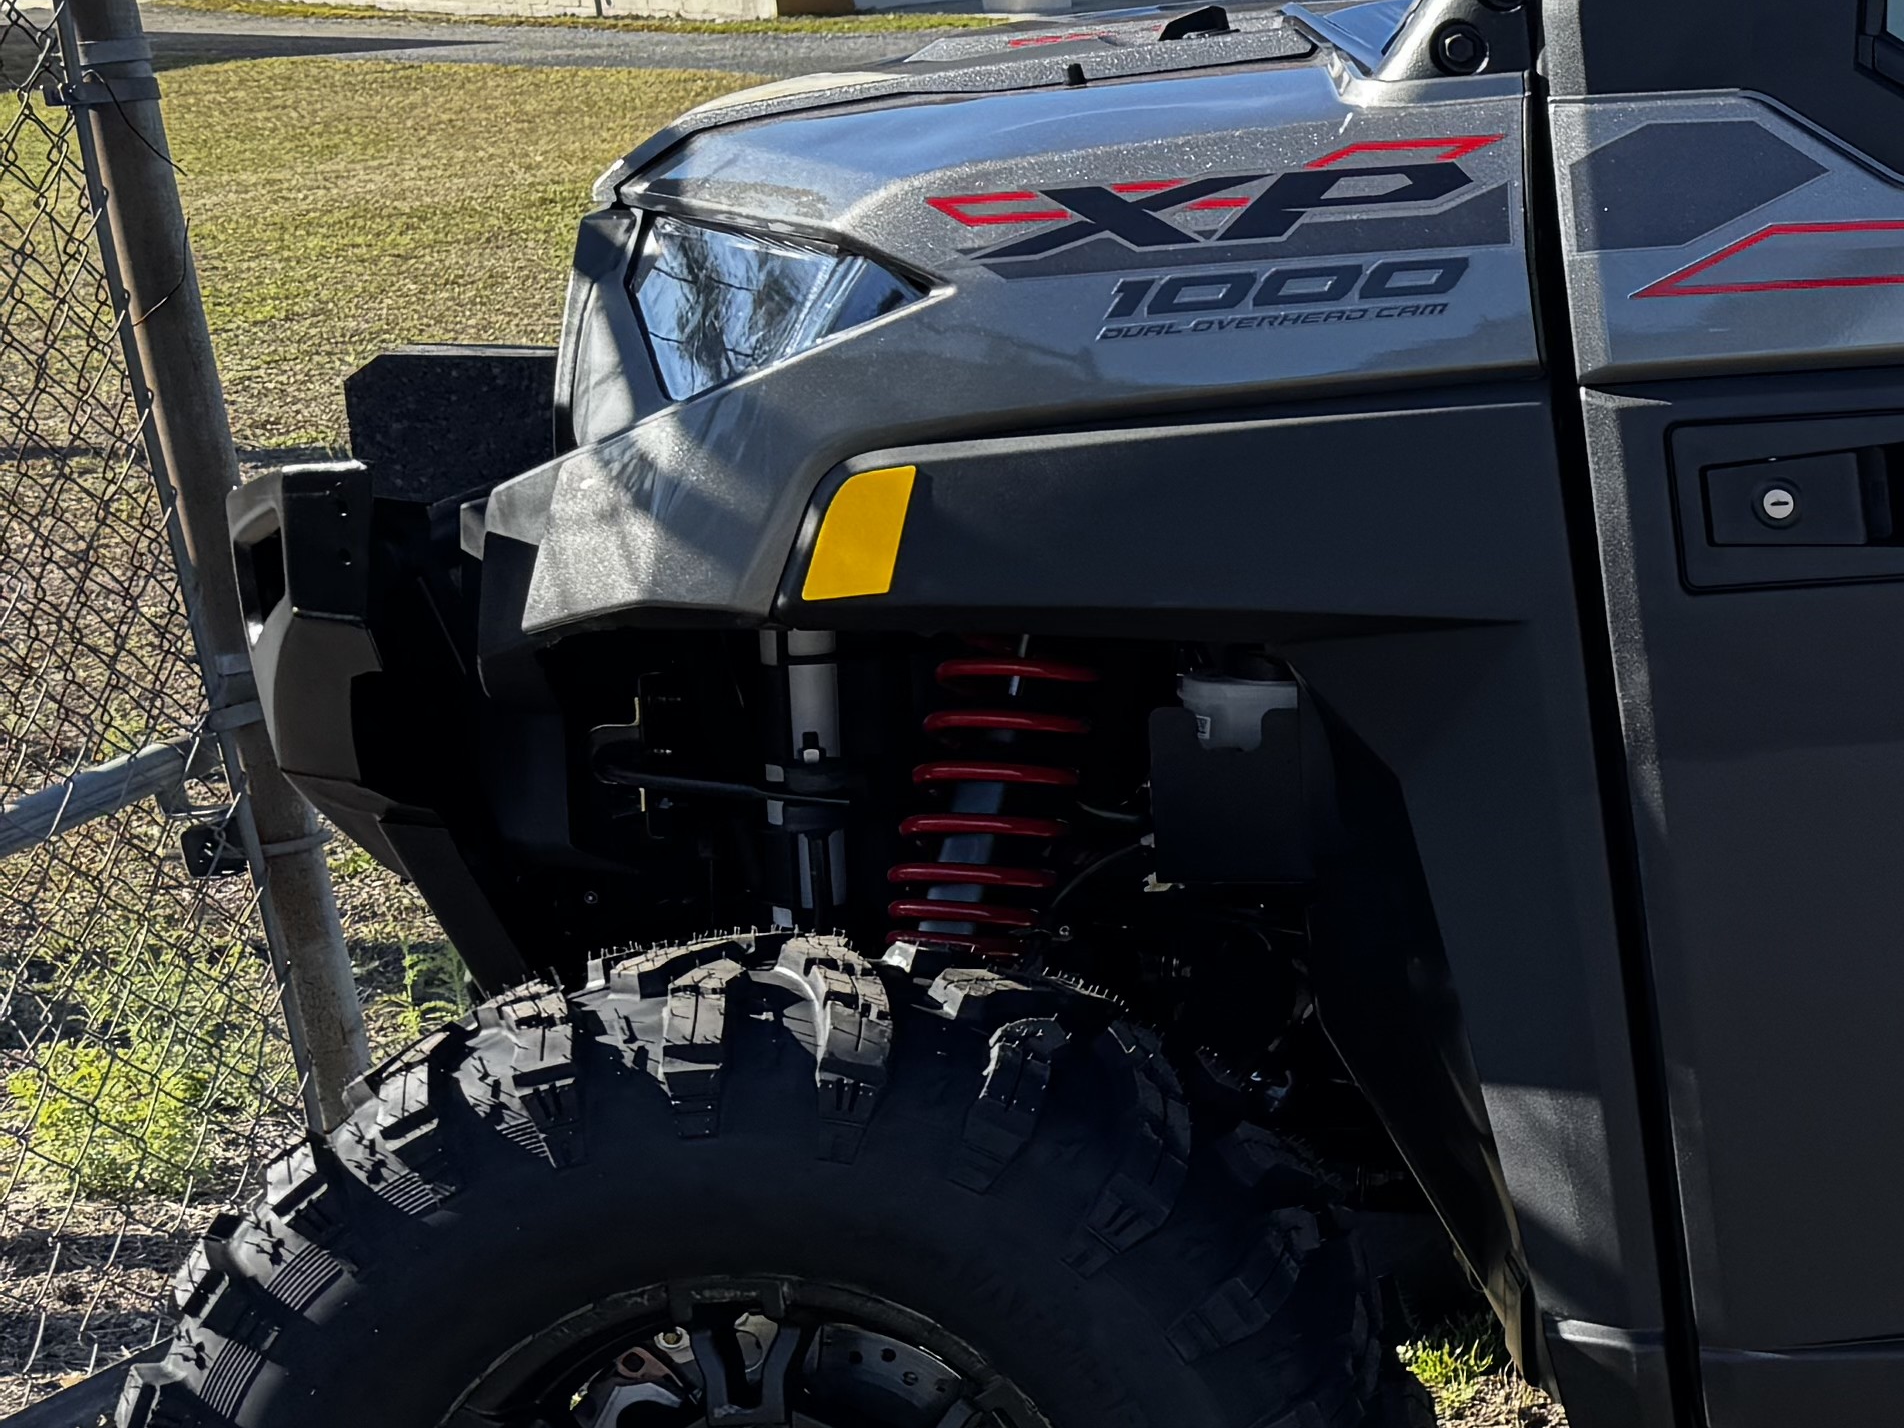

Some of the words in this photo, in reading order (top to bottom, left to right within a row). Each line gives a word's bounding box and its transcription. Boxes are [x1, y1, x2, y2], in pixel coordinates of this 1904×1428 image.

[969, 161, 1474, 260] XP
[1103, 256, 1470, 320] 1000
[1097, 322, 1184, 341] DUAL
[1190, 307, 1370, 333] OVERHEAD
[1374, 302, 1449, 319] CAM
